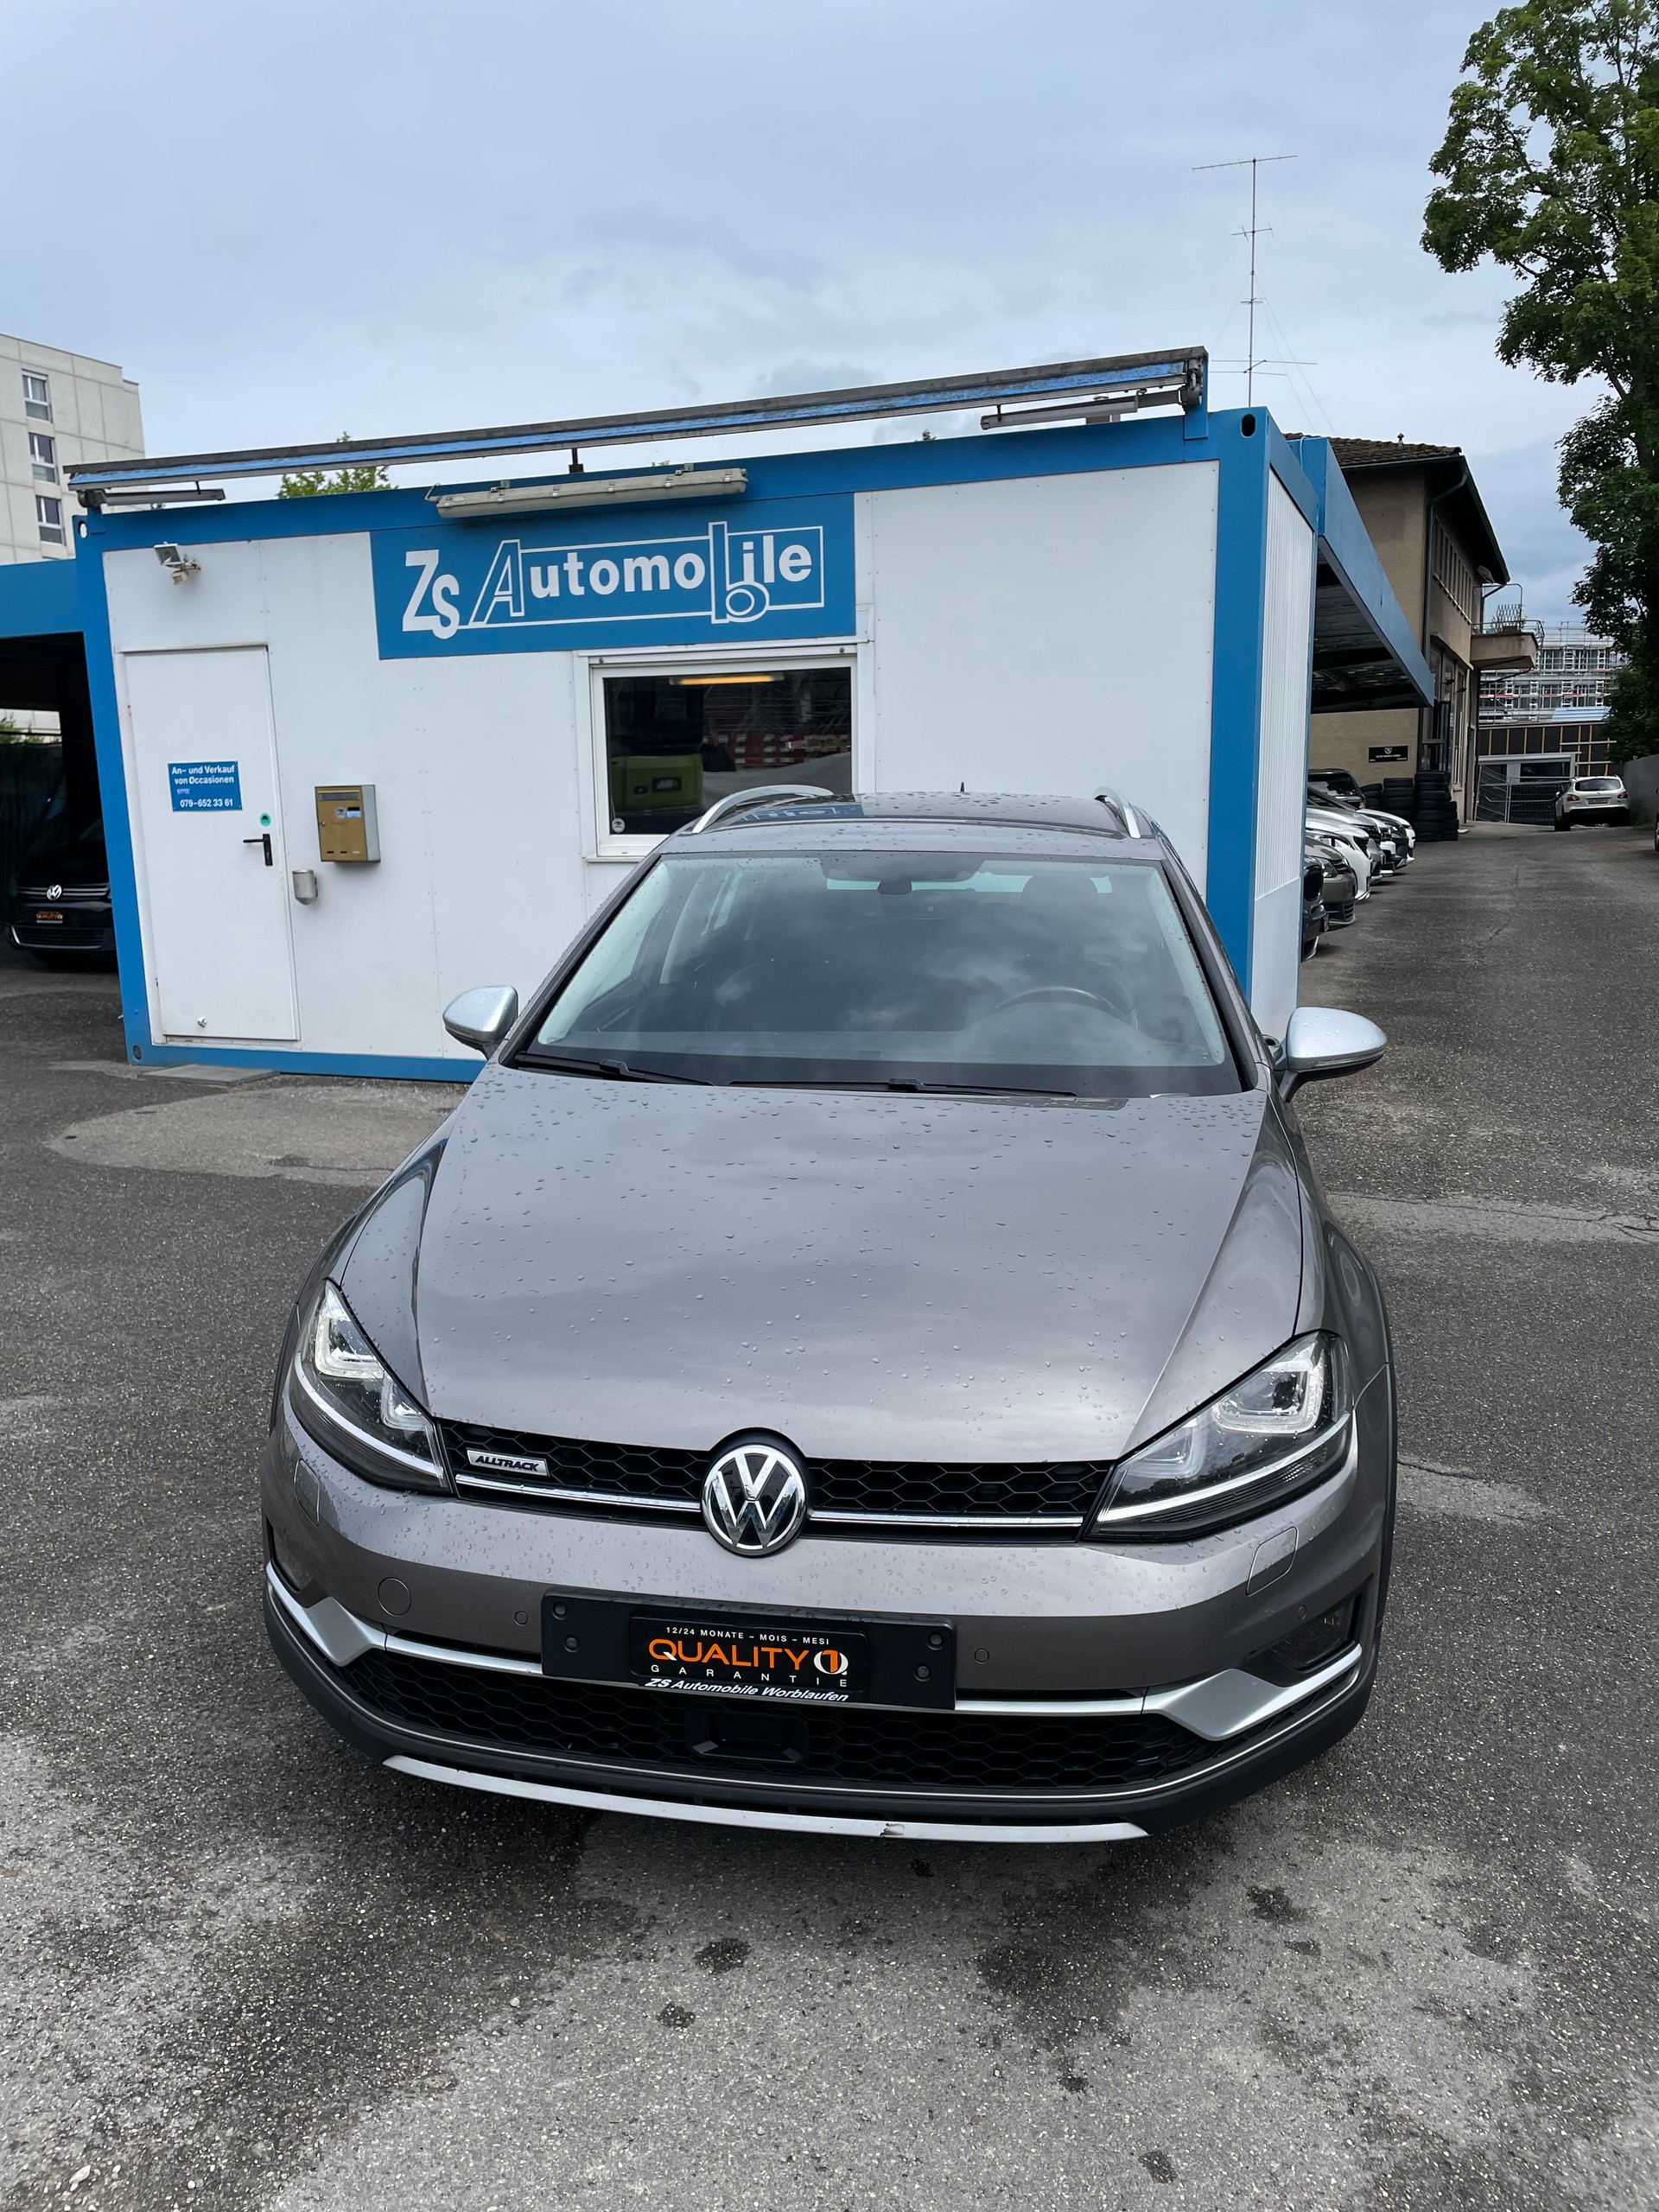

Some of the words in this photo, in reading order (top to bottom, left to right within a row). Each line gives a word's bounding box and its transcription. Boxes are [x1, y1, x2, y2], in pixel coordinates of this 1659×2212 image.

[468, 521, 814, 626] Automobile
[172, 766, 187, 775] An-
[188, 766, 203, 774] und
[204, 765, 235, 773] Verkauf
[188, 775, 234, 785] Occasionen
[180, 799, 212, 808] 079-652
[213, 798, 223, 807] 33
[225, 798, 233, 807] 61
[475, 1455, 539, 1471] ALLTRACK
[666, 1626, 696, 1636] 12/24
[700, 1629, 744, 1639] MONATE
[760, 1634, 787, 1643] MOIS
[803, 1637, 830, 1645] MESI
[648, 1638, 810, 1670] QUALITY
[651, 1664, 848, 1688] GARANTIE
[645, 1678, 672, 1688] ZS
[671, 1681, 759, 1696] Automobile
[761, 1687, 849, 1701] Worblaufen
